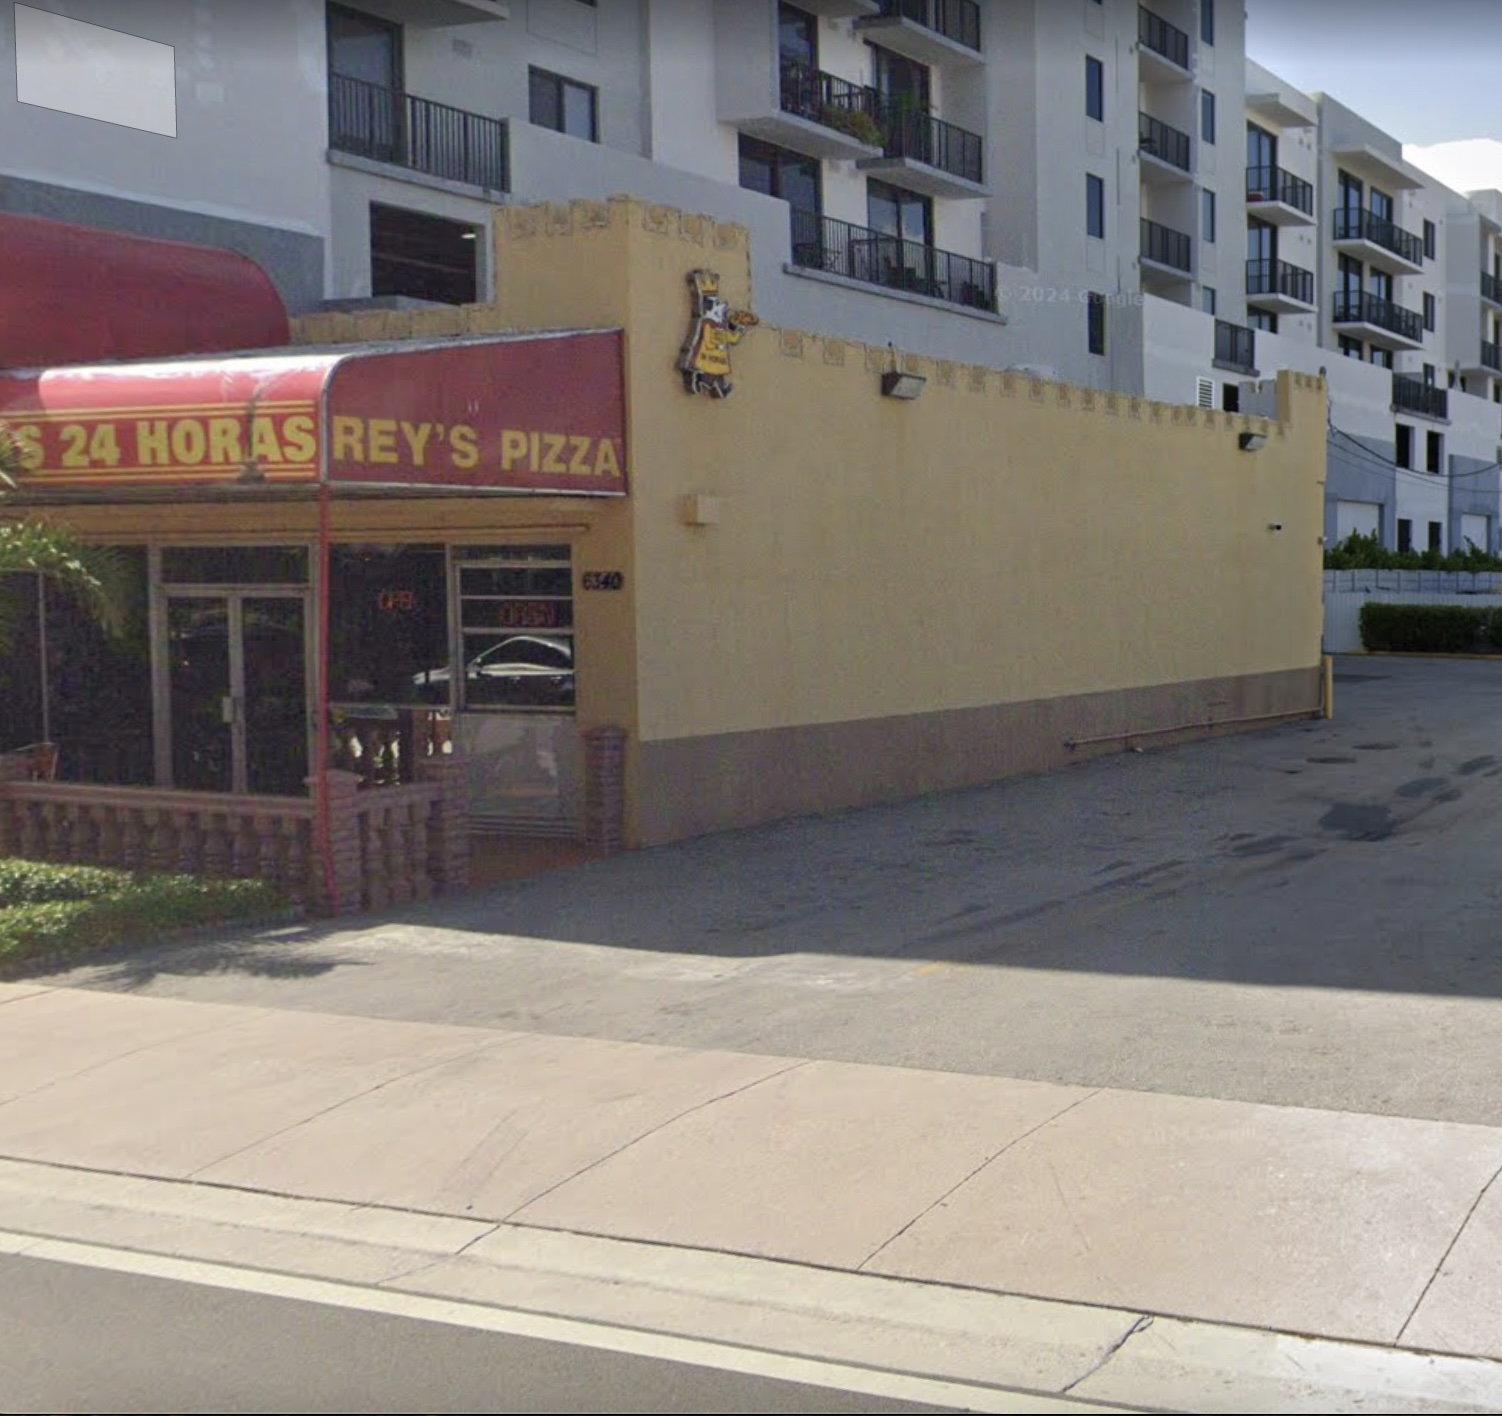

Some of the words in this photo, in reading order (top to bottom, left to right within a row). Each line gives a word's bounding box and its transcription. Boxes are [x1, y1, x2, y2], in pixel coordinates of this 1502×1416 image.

[59, 424, 120, 468] 24
[137, 415, 316, 465] HORAS
[331, 415, 480, 469] REY'S
[500, 429, 621, 477] PIZZA
[582, 571, 624, 591] 6340
